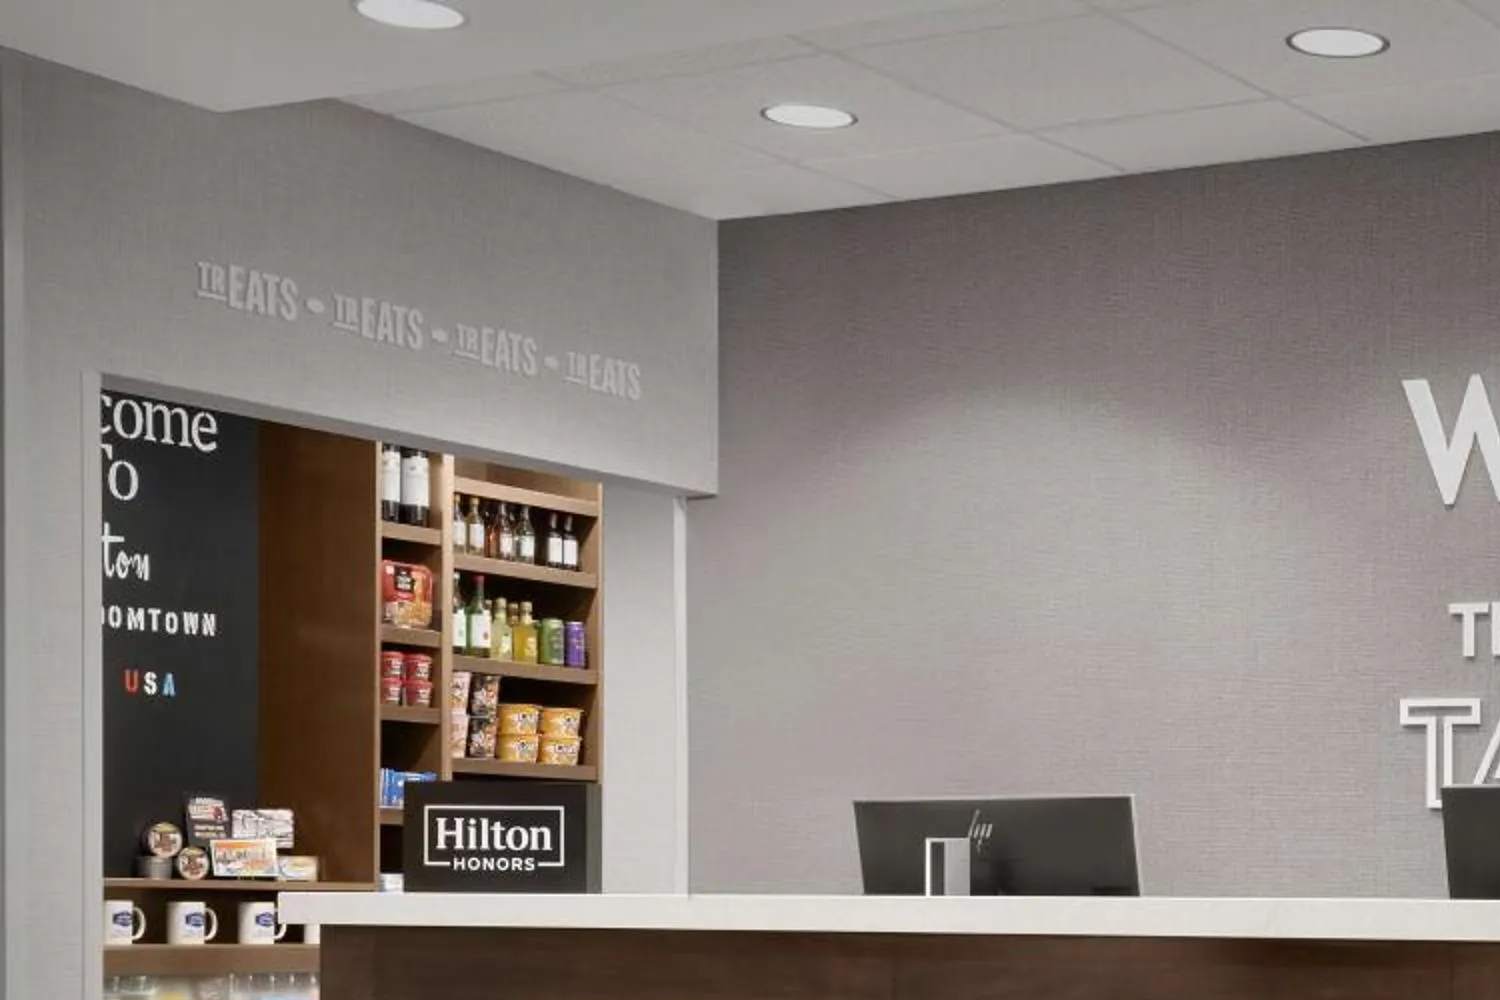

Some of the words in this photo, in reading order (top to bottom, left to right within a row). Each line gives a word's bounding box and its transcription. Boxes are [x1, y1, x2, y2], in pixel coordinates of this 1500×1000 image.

[101, 604, 217, 637] OMTOWN
[124, 668, 176, 697] USA
[436, 817, 553, 851] Hilton
[453, 857, 536, 871] HONORS
